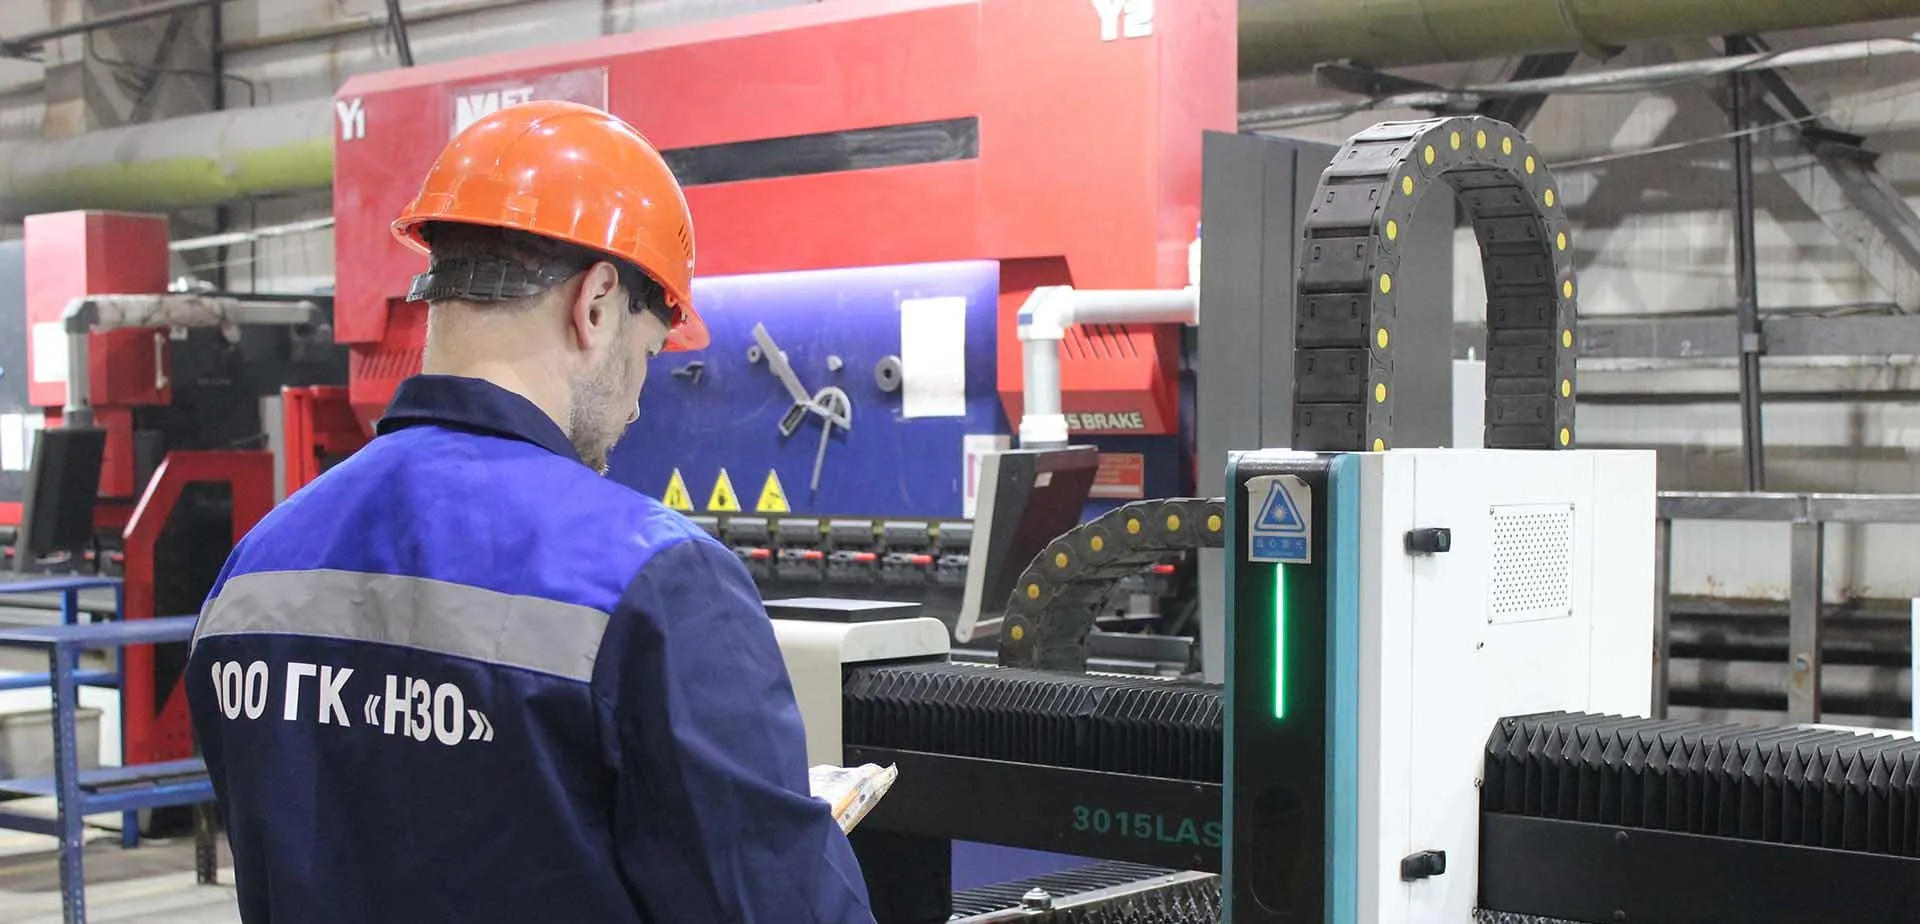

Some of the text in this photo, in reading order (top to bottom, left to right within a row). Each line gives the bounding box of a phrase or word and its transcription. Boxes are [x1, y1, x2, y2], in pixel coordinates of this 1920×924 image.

[1089, 0, 1154, 40] Y2
[1081, 411, 1145, 430] BRAKE
[283, 662, 355, 727] ГК
